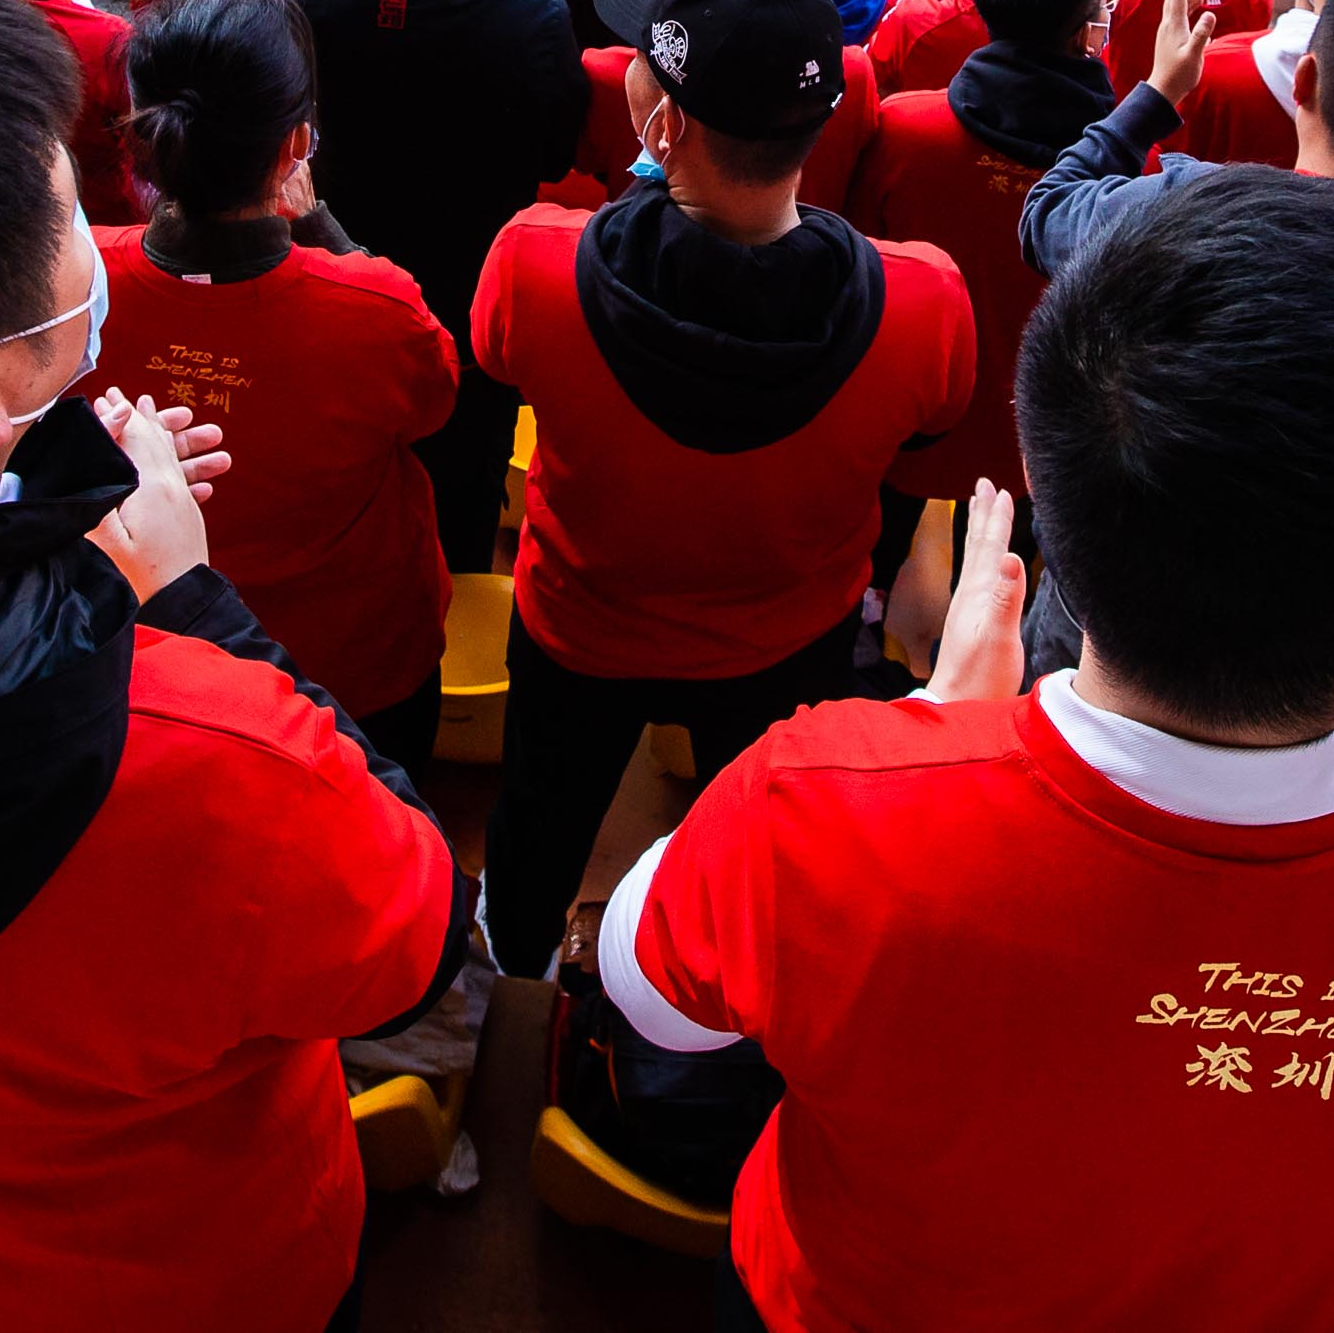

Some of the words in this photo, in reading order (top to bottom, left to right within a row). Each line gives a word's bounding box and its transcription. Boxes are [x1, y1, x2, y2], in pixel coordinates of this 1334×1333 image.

[145, 355, 253, 388] SHENZHEN
[169, 344, 214, 364] THIS
[220, 357, 240, 369] IS
[167, 380, 231, 414] 深圳
[1197, 962, 1304, 999] THIS
